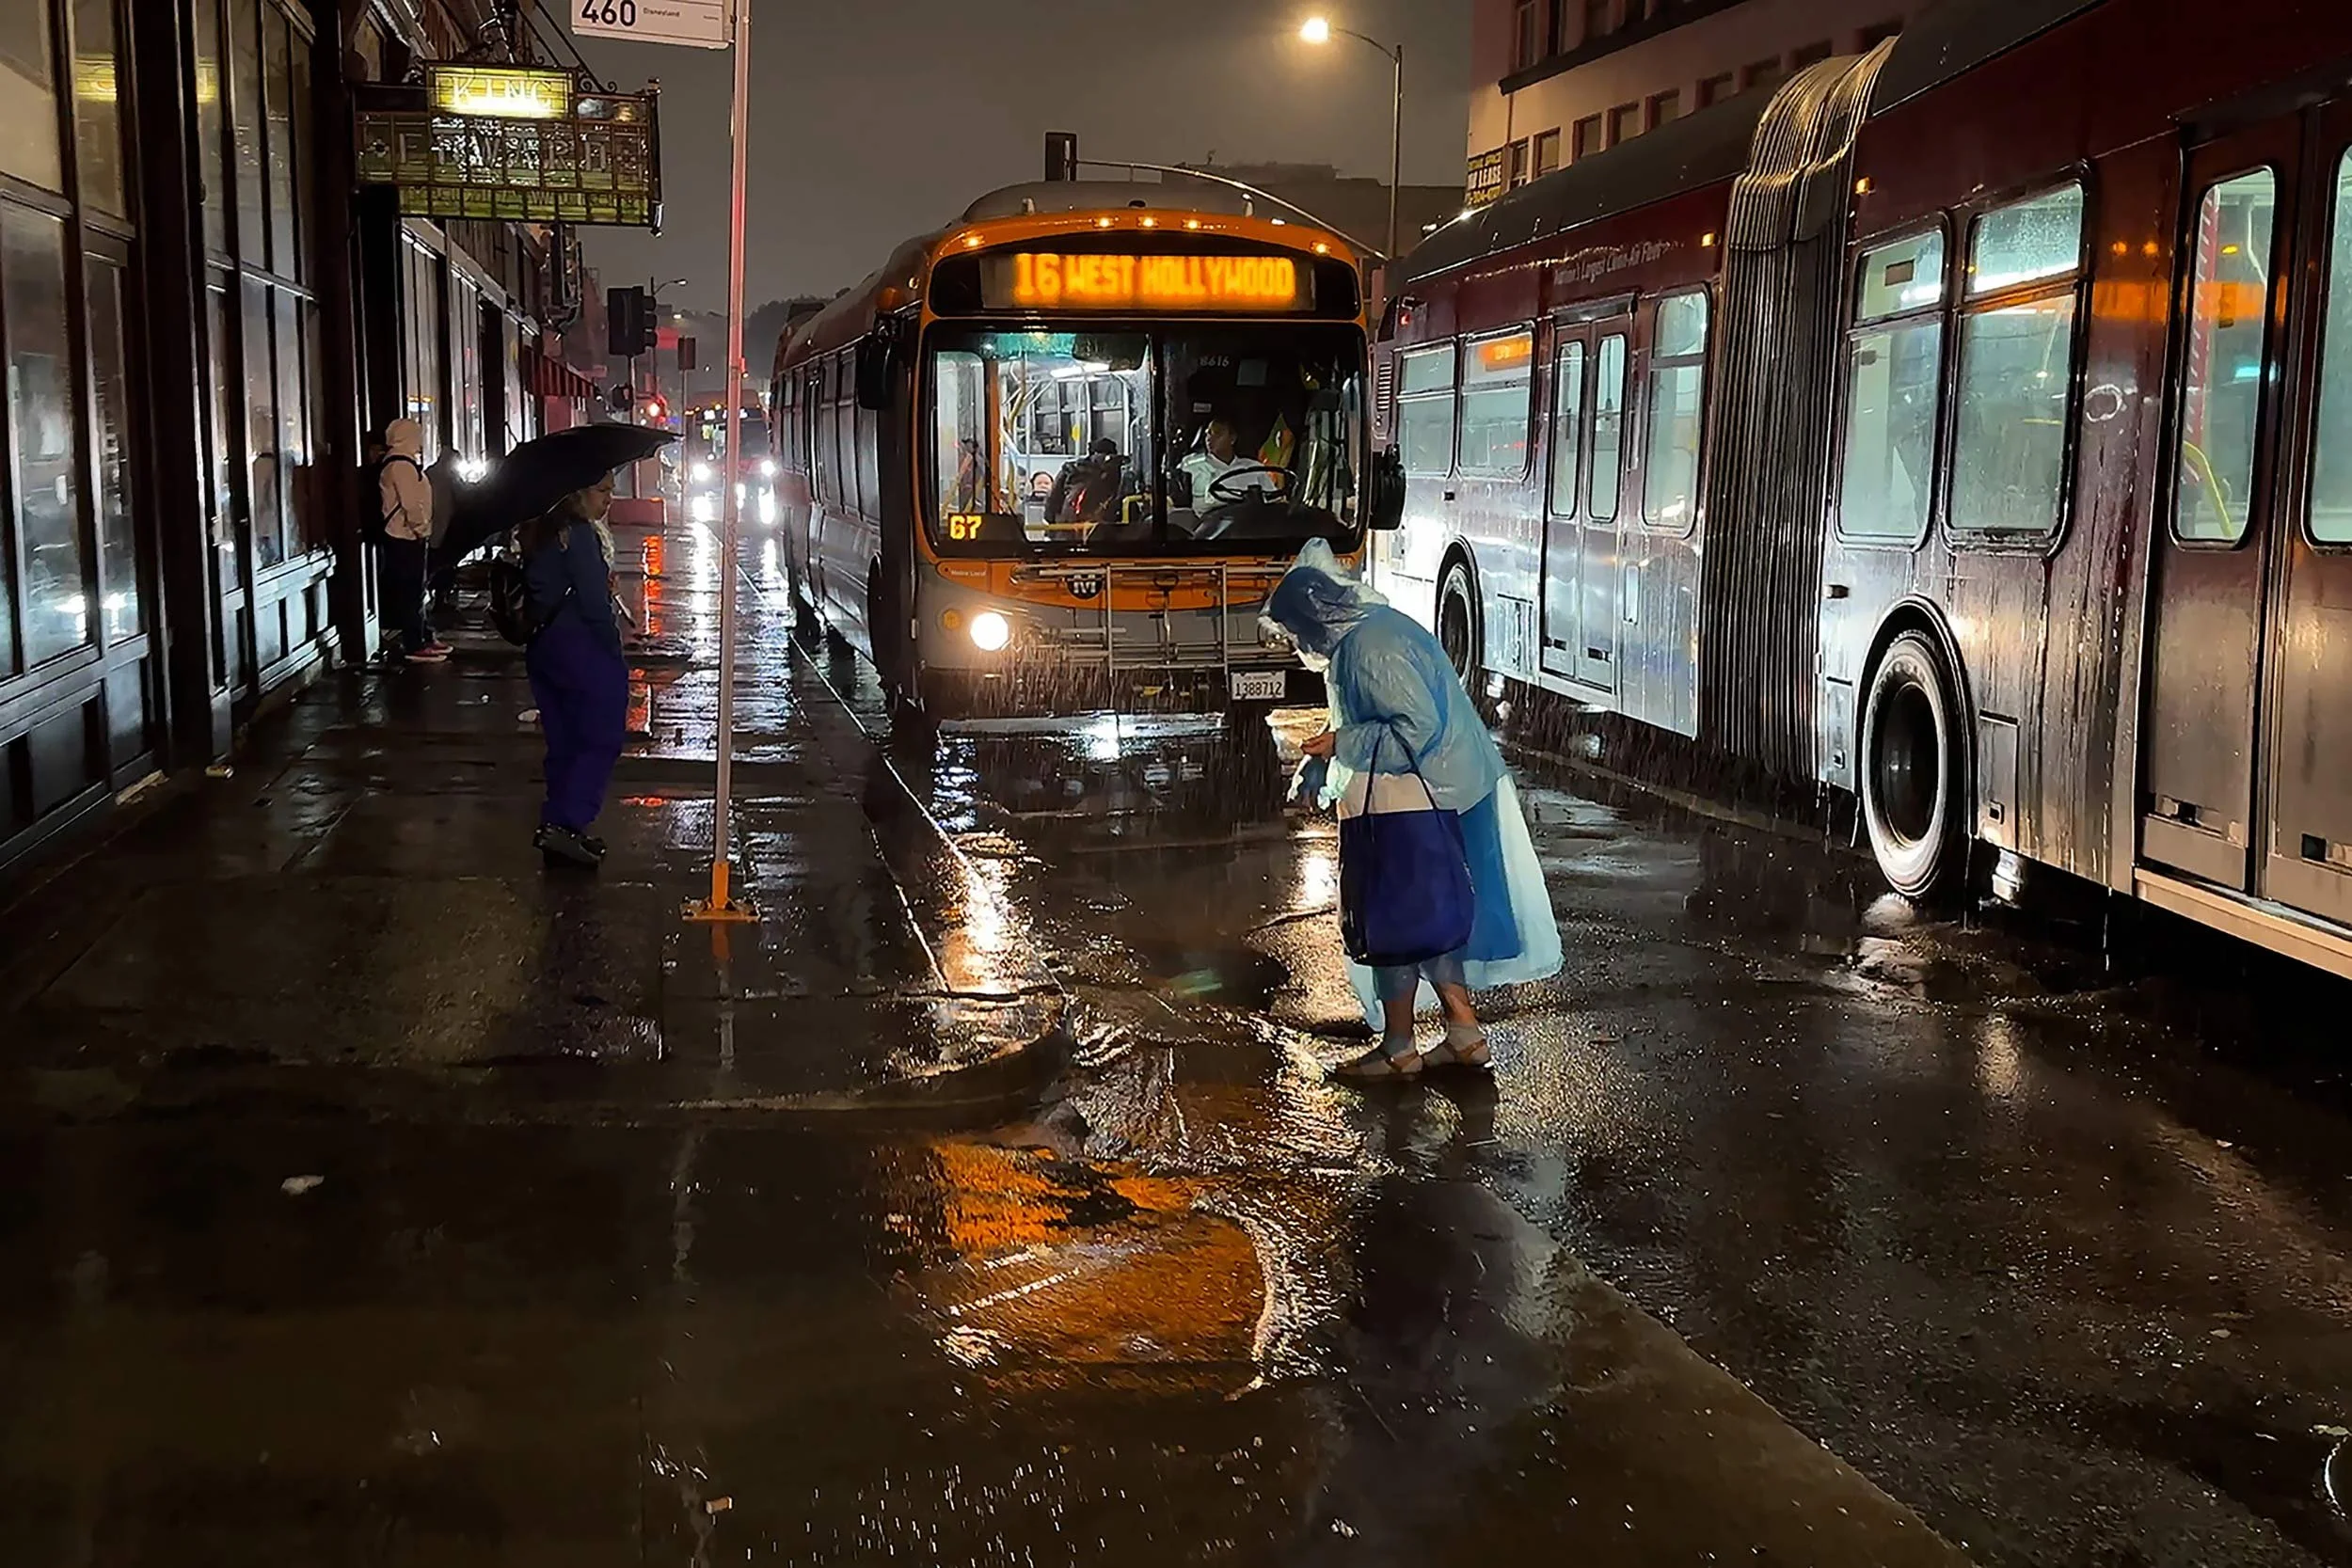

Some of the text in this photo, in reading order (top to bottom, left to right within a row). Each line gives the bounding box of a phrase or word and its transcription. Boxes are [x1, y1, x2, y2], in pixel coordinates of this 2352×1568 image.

[581, 0, 636, 26] 460
[452, 75, 551, 110] KING
[1016, 253, 1295, 297] 16 WEST HOLLYWOOD
[949, 515, 982, 540] 67
[1234, 681, 1282, 696] 1388712
